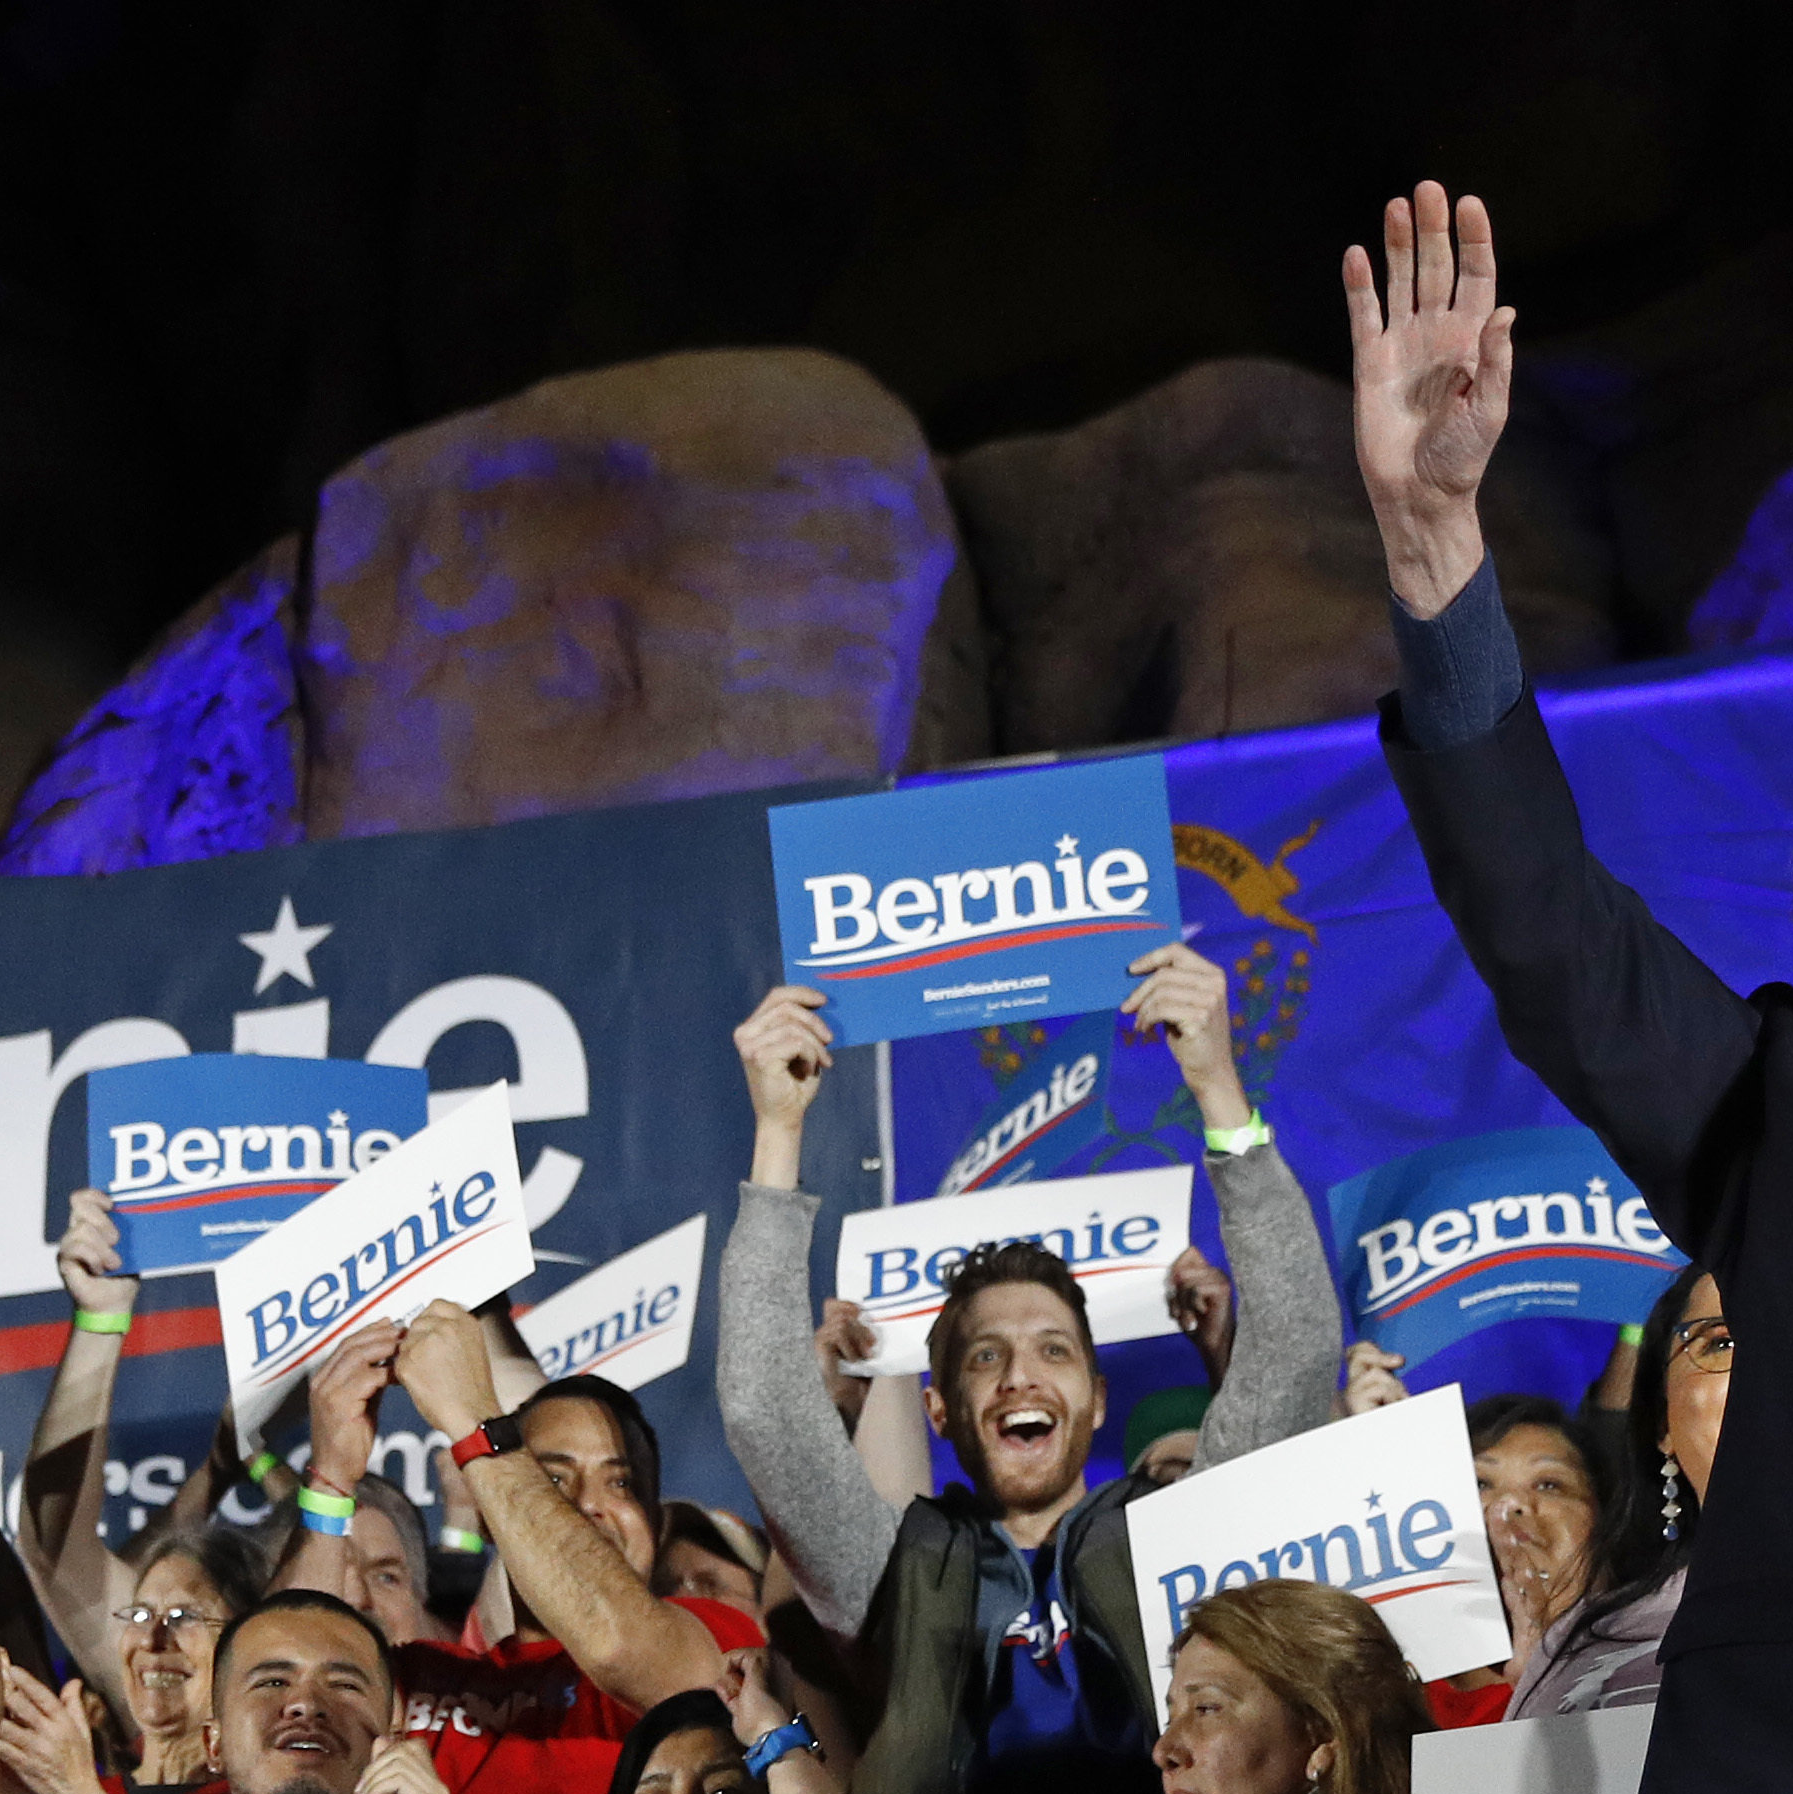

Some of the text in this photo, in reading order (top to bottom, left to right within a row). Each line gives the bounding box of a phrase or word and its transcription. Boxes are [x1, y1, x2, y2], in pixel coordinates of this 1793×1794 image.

[805, 833, 1148, 956] Bernie
[246, 1170, 496, 1367] Bernie
[863, 1210, 1161, 1301] Benie
[1357, 1177, 1672, 1300] Bernie
[538, 1285, 680, 1383] ernie
